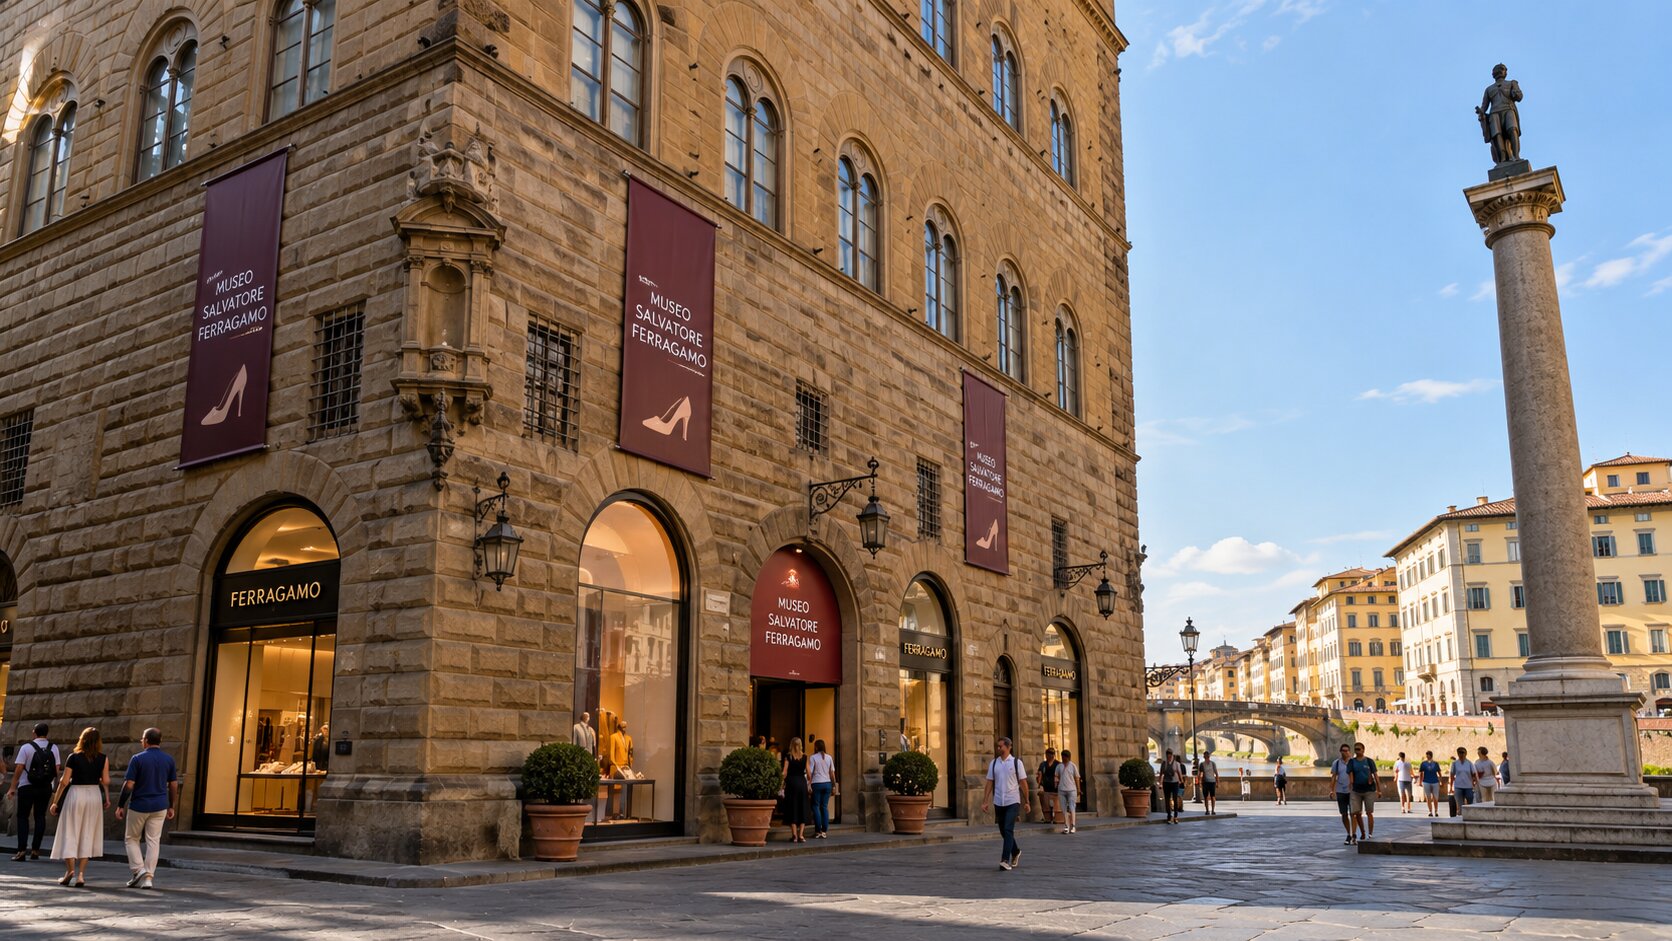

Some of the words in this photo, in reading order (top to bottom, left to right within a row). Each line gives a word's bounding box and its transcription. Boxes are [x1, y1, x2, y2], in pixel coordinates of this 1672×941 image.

[216, 269, 253, 296] MUSEO
[202, 285, 265, 320] SALVATORE
[650, 291, 691, 321] MUSEO
[198, 305, 267, 342] FERRAGAMO
[635, 304, 703, 348] SALVATORE
[632, 323, 707, 368] FERRAGAMO
[230, 581, 321, 608] FERRAGAMO
[778, 597, 810, 614] MUSEO
[768, 612, 818, 633] SALVATORE
[765, 630, 821, 651] FERRAGAMO
